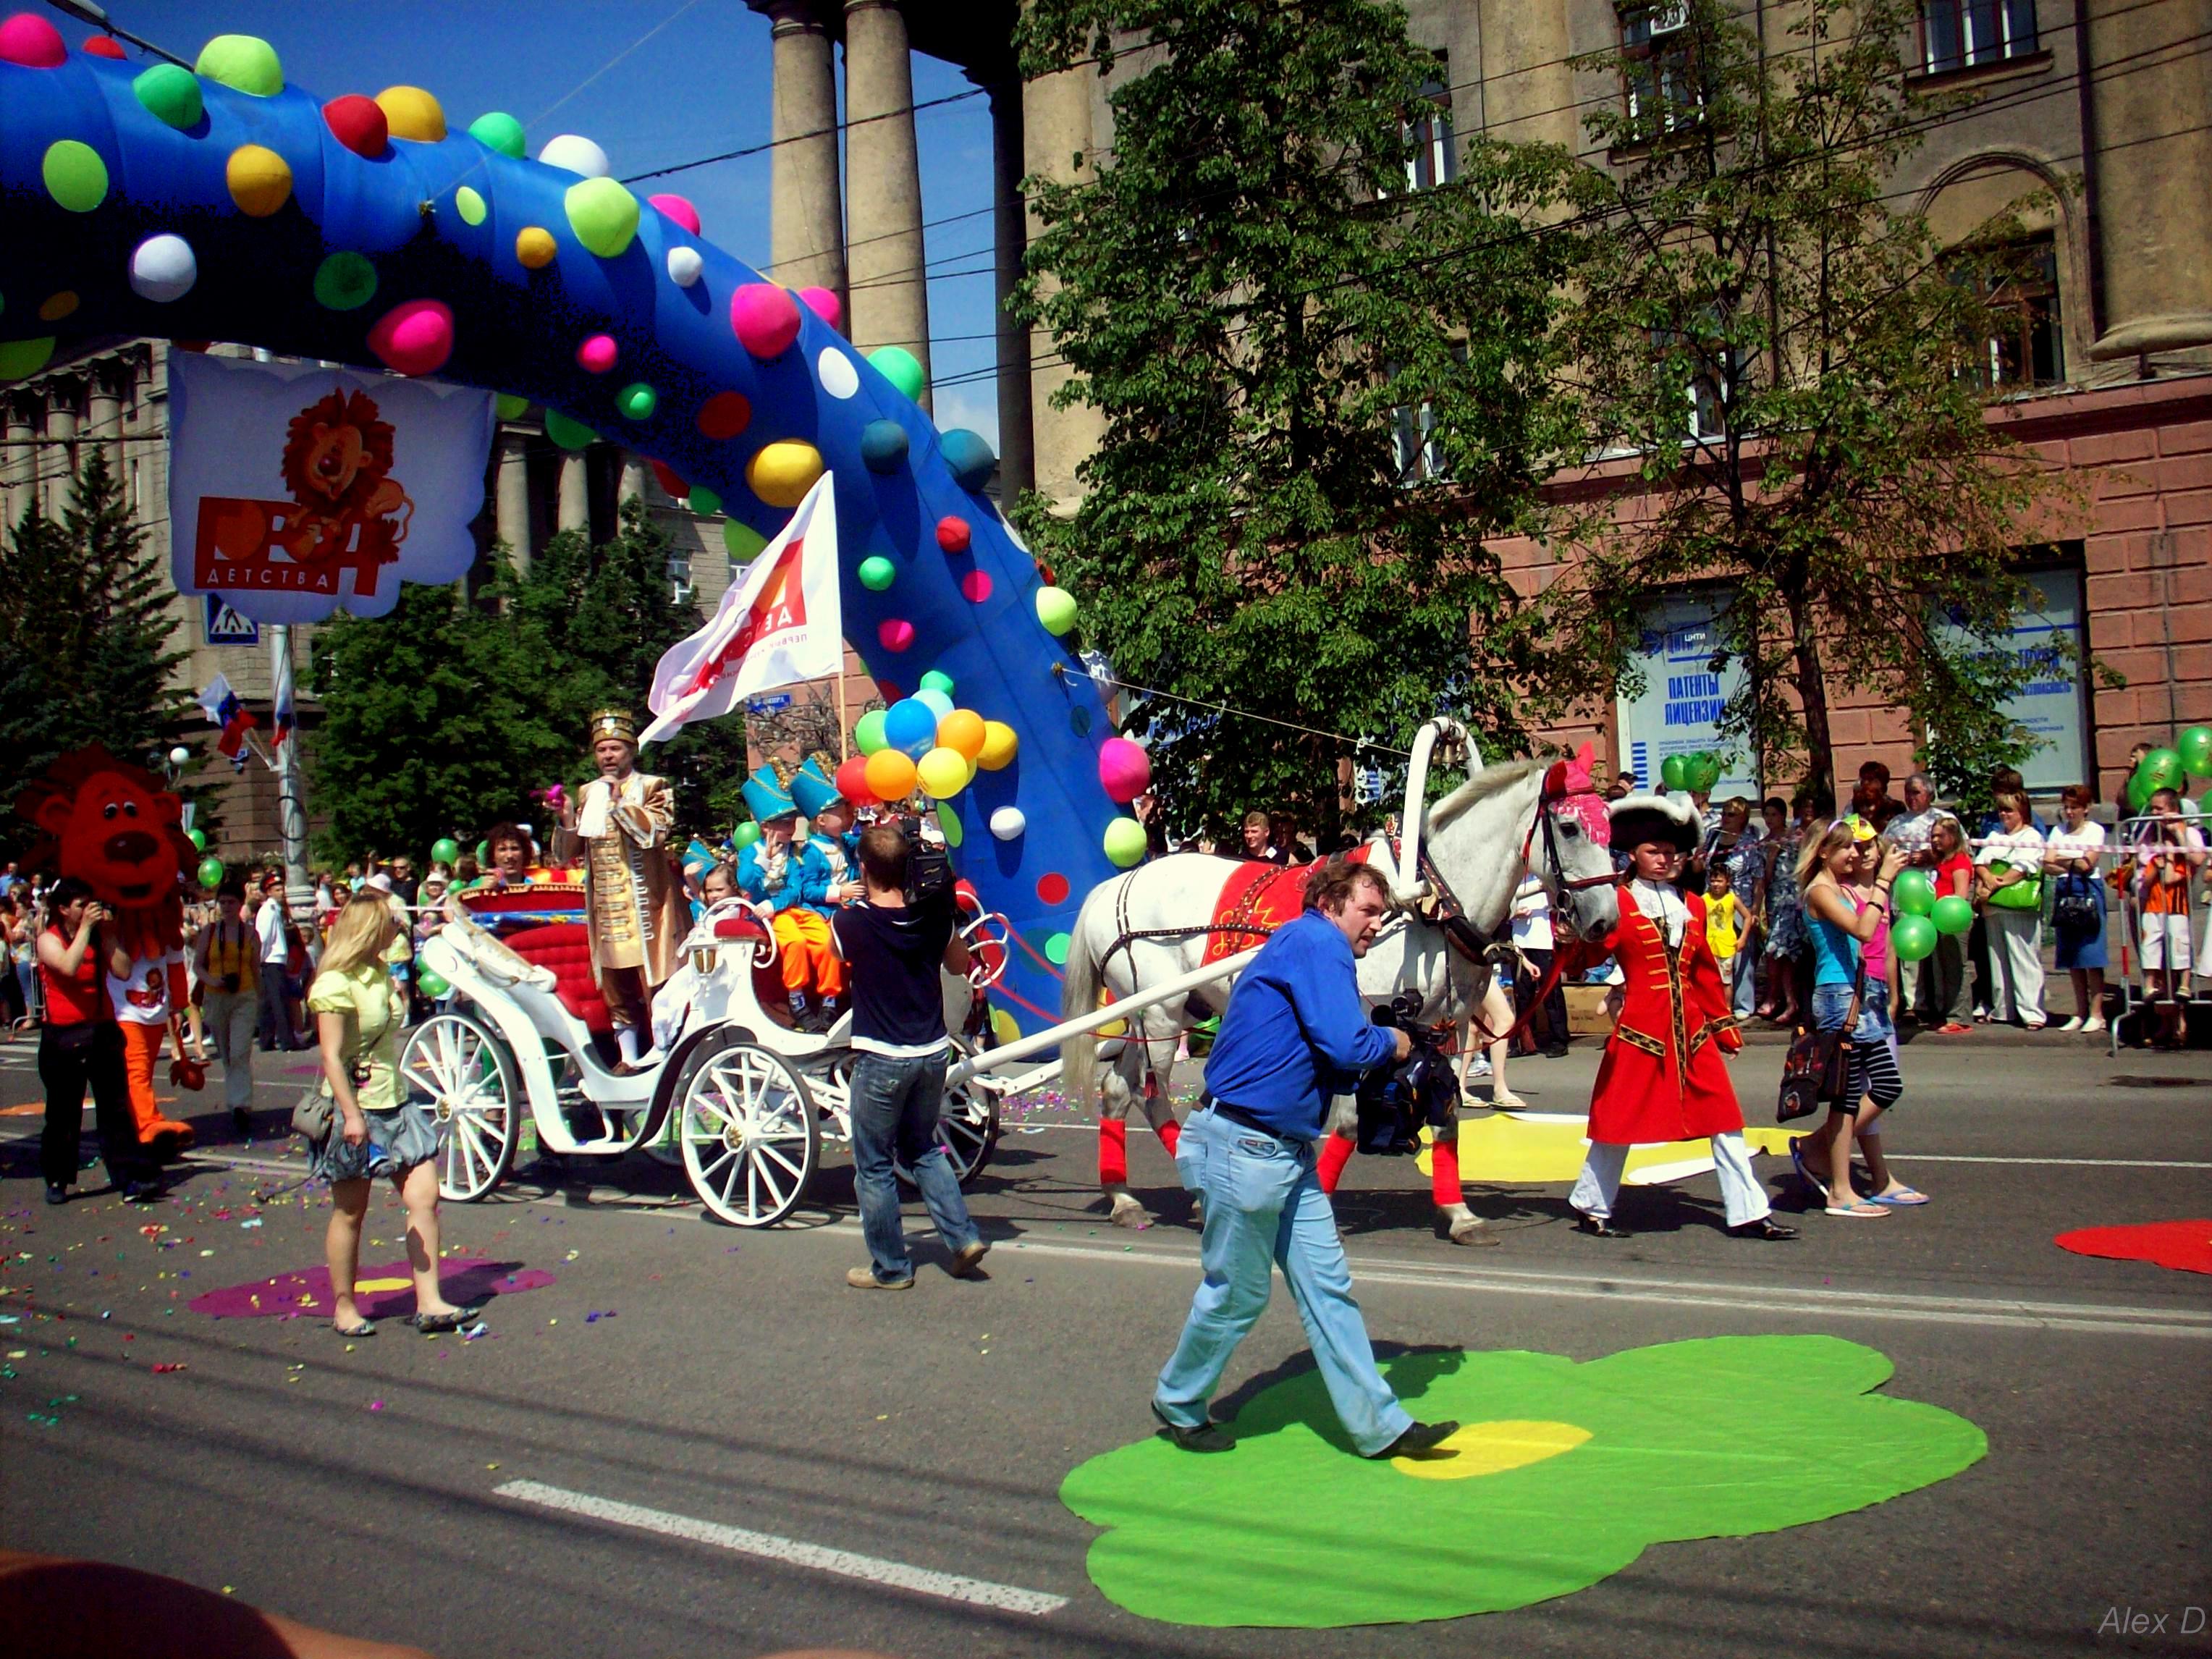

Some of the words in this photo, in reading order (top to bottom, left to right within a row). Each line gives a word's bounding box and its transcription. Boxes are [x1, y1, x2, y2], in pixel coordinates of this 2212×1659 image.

[207, 568, 329, 588] ДЕТСТВА
[1668, 673, 1720, 700] ПАТЕНТЫ
[1664, 698, 1726, 727] ЛИЦЕНЗИИ
